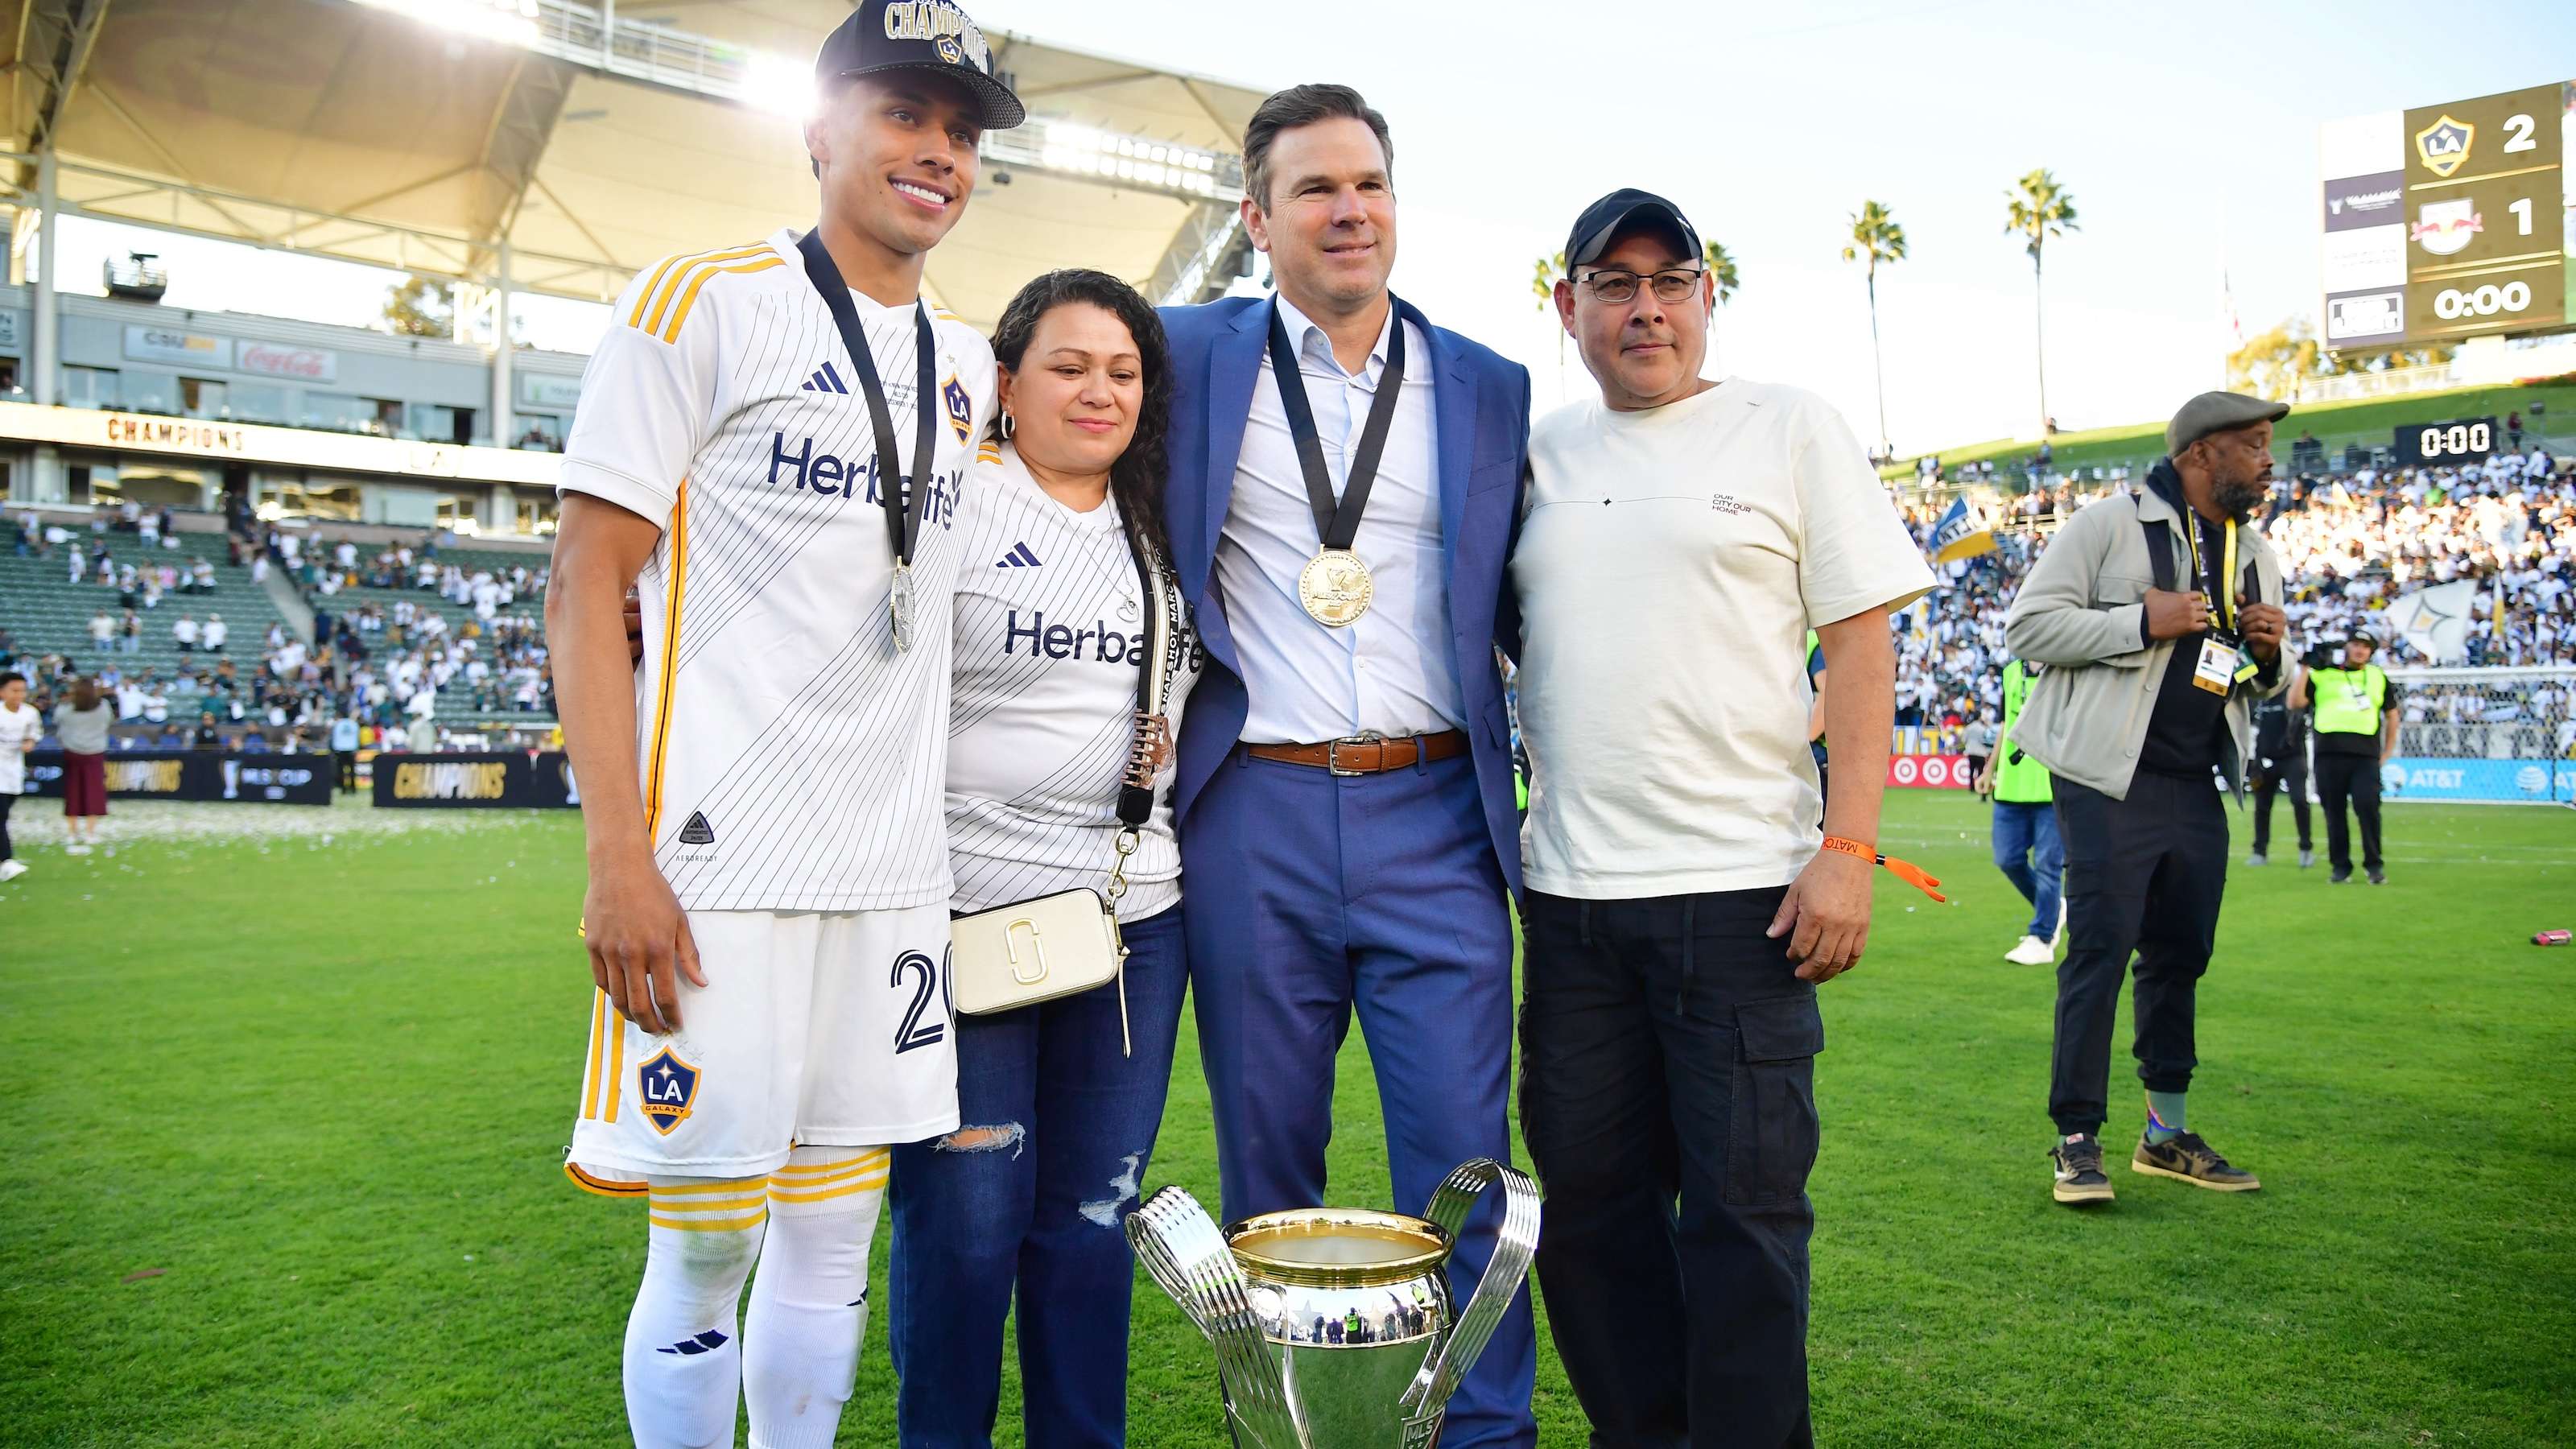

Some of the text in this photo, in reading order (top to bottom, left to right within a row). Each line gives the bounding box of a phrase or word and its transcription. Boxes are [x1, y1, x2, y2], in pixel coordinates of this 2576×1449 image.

[943, 45, 956, 56] LA
[2429, 114, 2537, 156] LA 2
[2508, 197, 2533, 236] 1
[2434, 281, 2531, 320] 0:00
[950, 397, 969, 422] LA
[108, 418, 242, 451] CHAMPIONS
[2421, 423, 2491, 458] 0:00
[767, 431, 953, 530] Herbife
[1711, 505, 1738, 516] HOME
[1712, 499, 1752, 514] CITY OUR
[1713, 493, 1734, 501] OUR
[1166, 584, 1179, 623] MARC
[1005, 609, 1203, 674] Herbafe
[1160, 628, 1179, 714] SNAPSHOT
[2409, 768, 2466, 788] AT&T
[648, 1076, 684, 1102] LA
[645, 1105, 685, 1114] GALAXY
[1406, 1418, 1434, 1443] MLS
